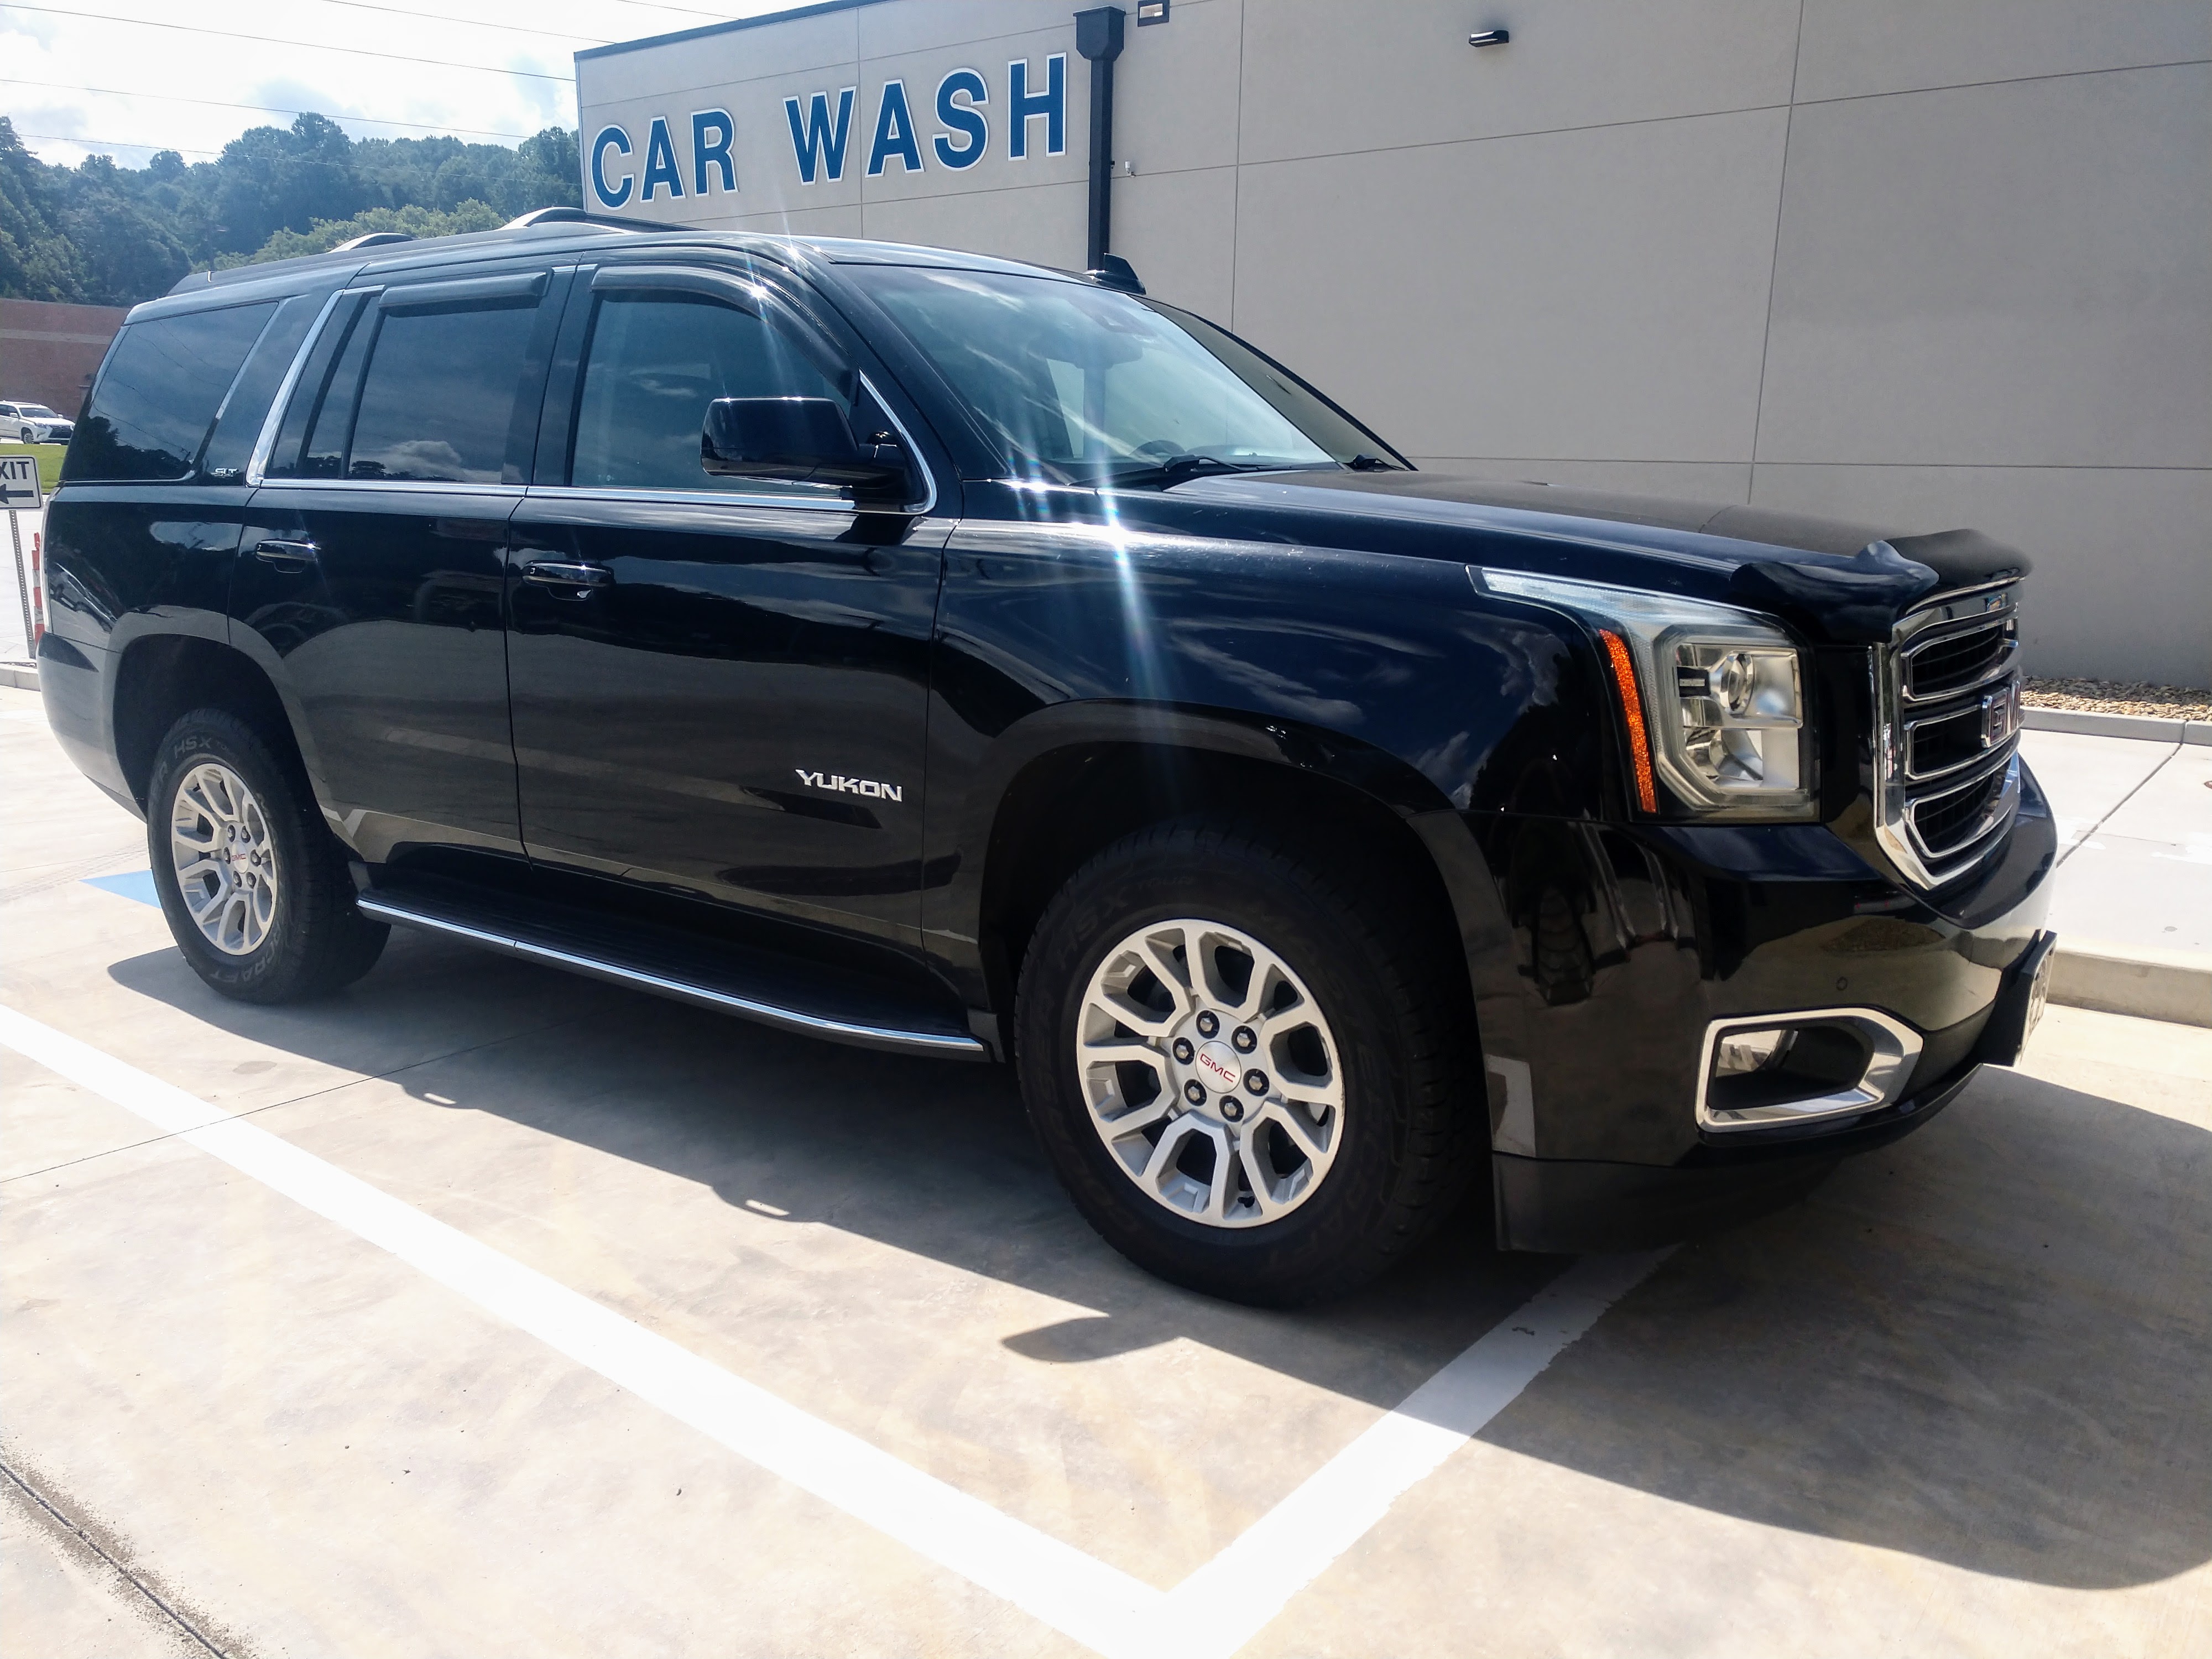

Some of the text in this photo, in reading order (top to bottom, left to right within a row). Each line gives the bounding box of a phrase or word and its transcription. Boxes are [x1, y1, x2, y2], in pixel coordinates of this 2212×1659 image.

[590, 51, 1068, 211] CAR WASH
[0, 461, 30, 479] XIT
[211, 468, 238, 477] SLT
[795, 769, 902, 802] YUKON
[1200, 1053, 1236, 1083] GMC
